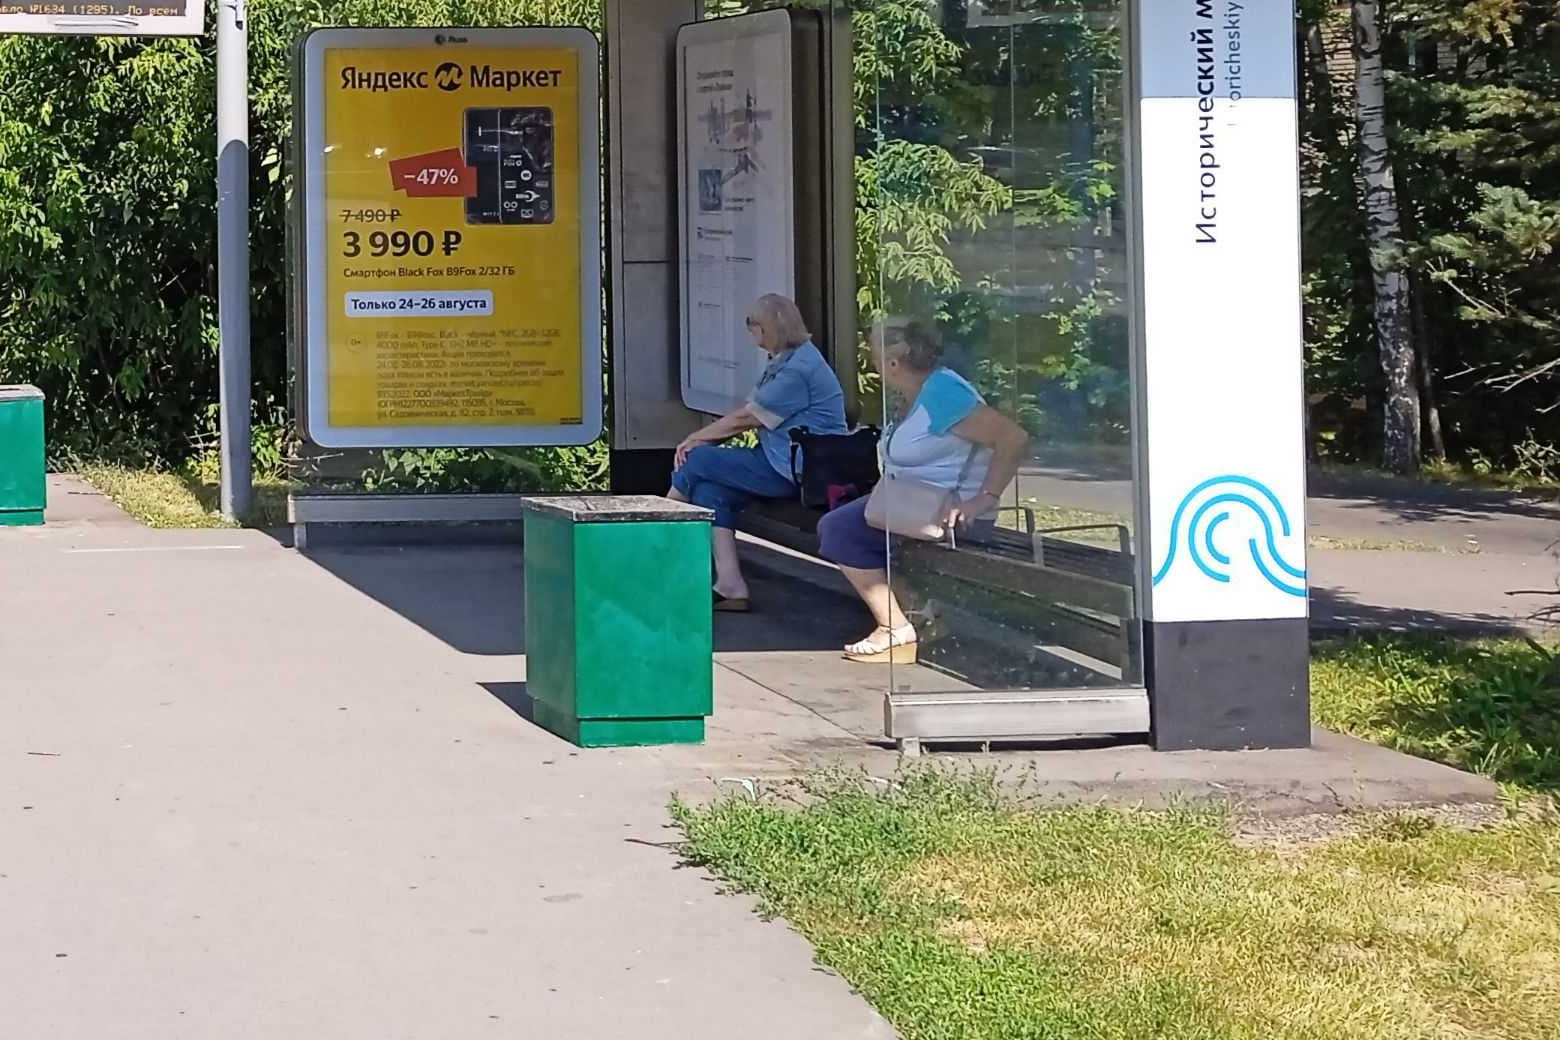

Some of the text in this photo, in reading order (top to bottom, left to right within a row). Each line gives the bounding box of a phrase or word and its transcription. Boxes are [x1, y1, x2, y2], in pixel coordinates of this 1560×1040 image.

[128, 5, 143, 15] По
[1223, 1, 1244, 128] oricheskiy
[341, 65, 562, 93] Яндекс Маркет
[1190, 29, 1220, 244] Исторический
[368, 230, 435, 257] 990
[343, 266, 515, 278] Смартфон Black Fox B9Fox 2/32 ГБ
[351, 298, 396, 310] Только
[438, 299, 487, 312] августа
